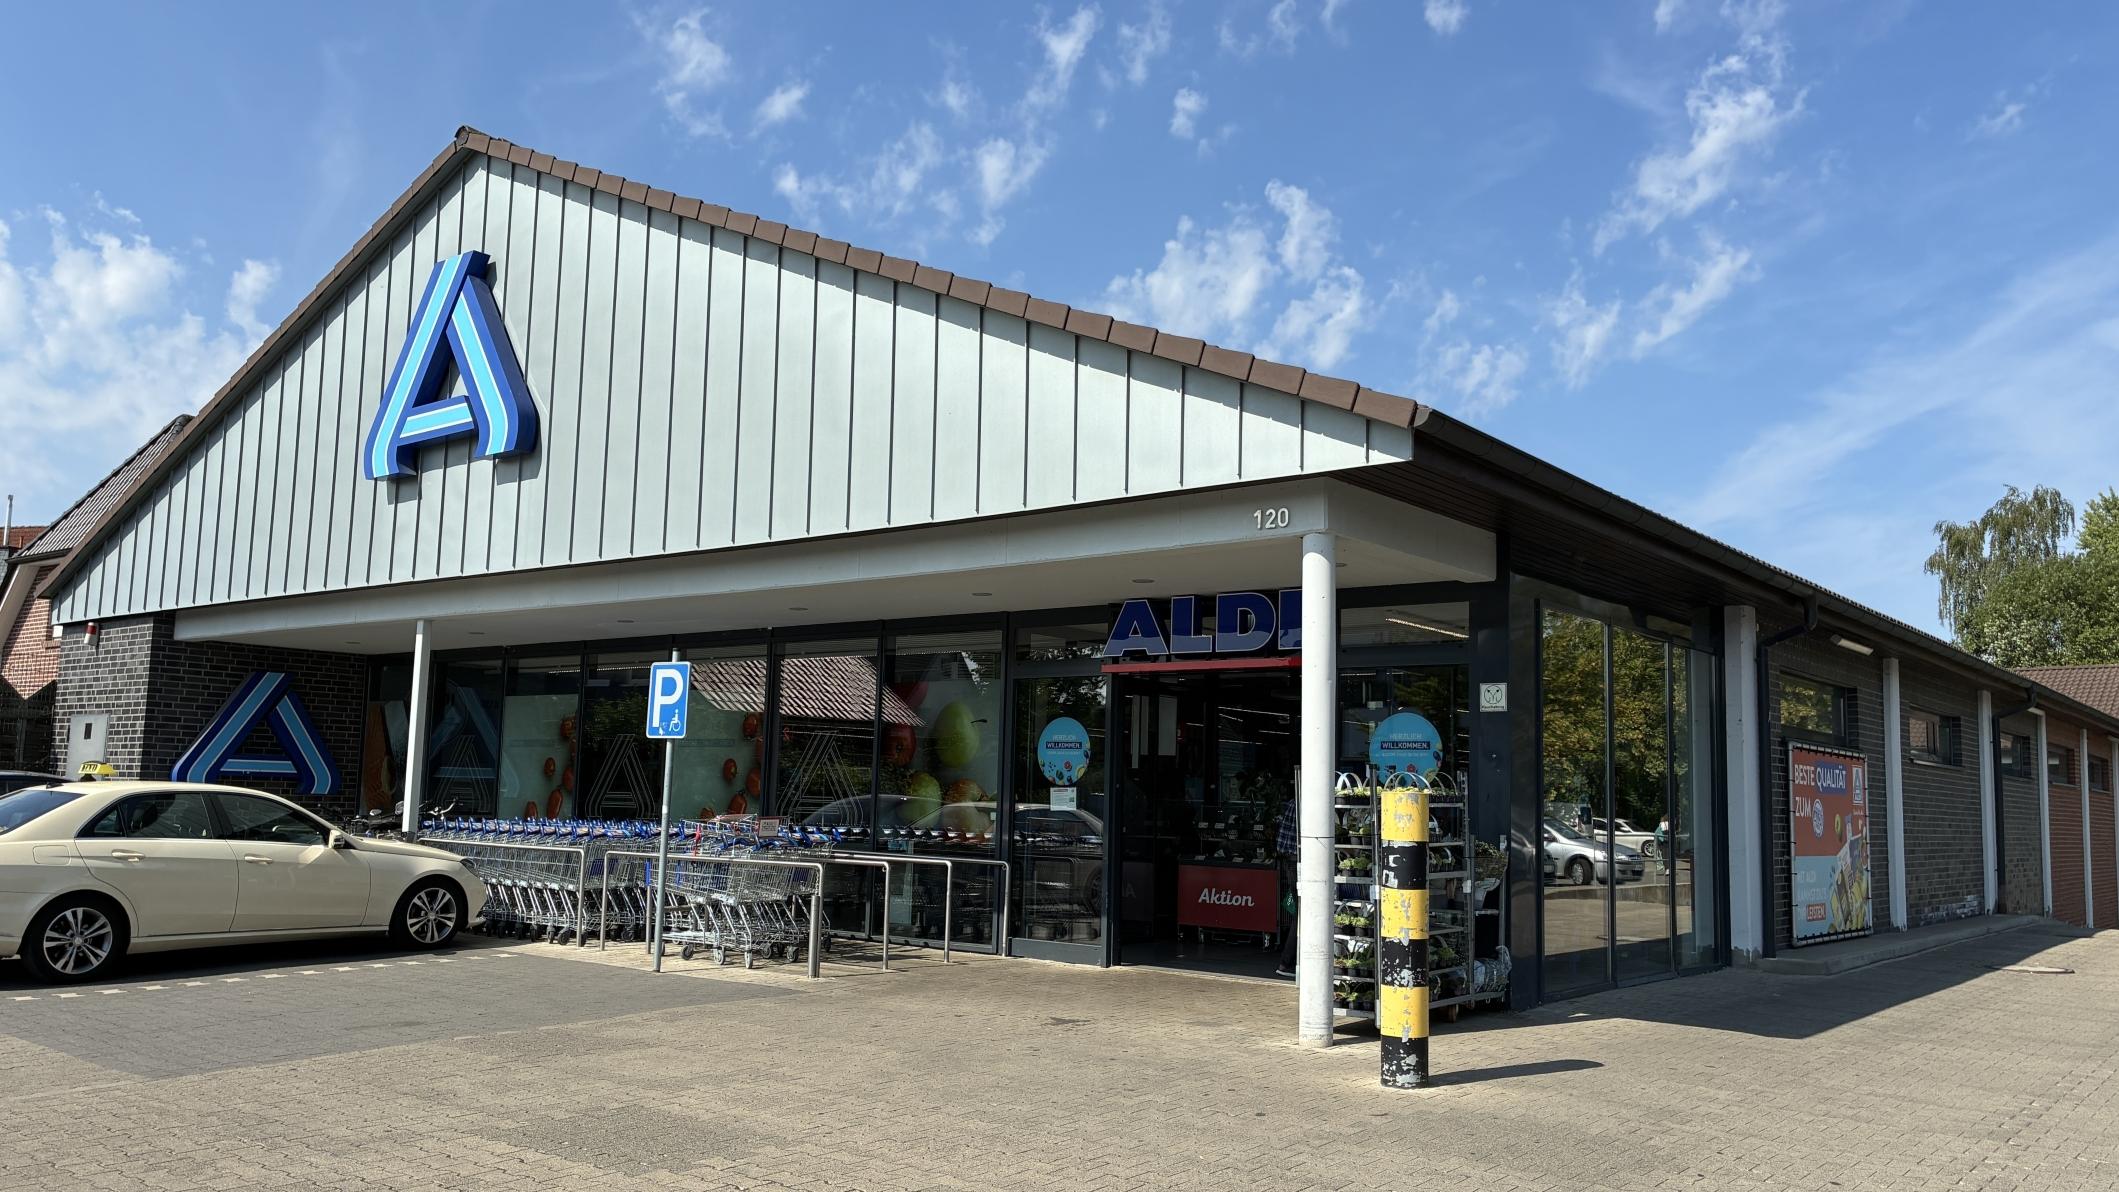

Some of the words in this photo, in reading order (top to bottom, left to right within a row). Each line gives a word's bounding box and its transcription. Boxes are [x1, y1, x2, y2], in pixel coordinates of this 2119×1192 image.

[1253, 507, 1289, 529] 120
[1102, 588, 1303, 657] ALDI
[652, 668, 684, 728] P
[1794, 764, 1815, 786] BESTE
[1816, 765, 1847, 792] QUALITÄT
[1795, 796, 1812, 817] ZUM
[1198, 887, 1255, 907] Aktion
